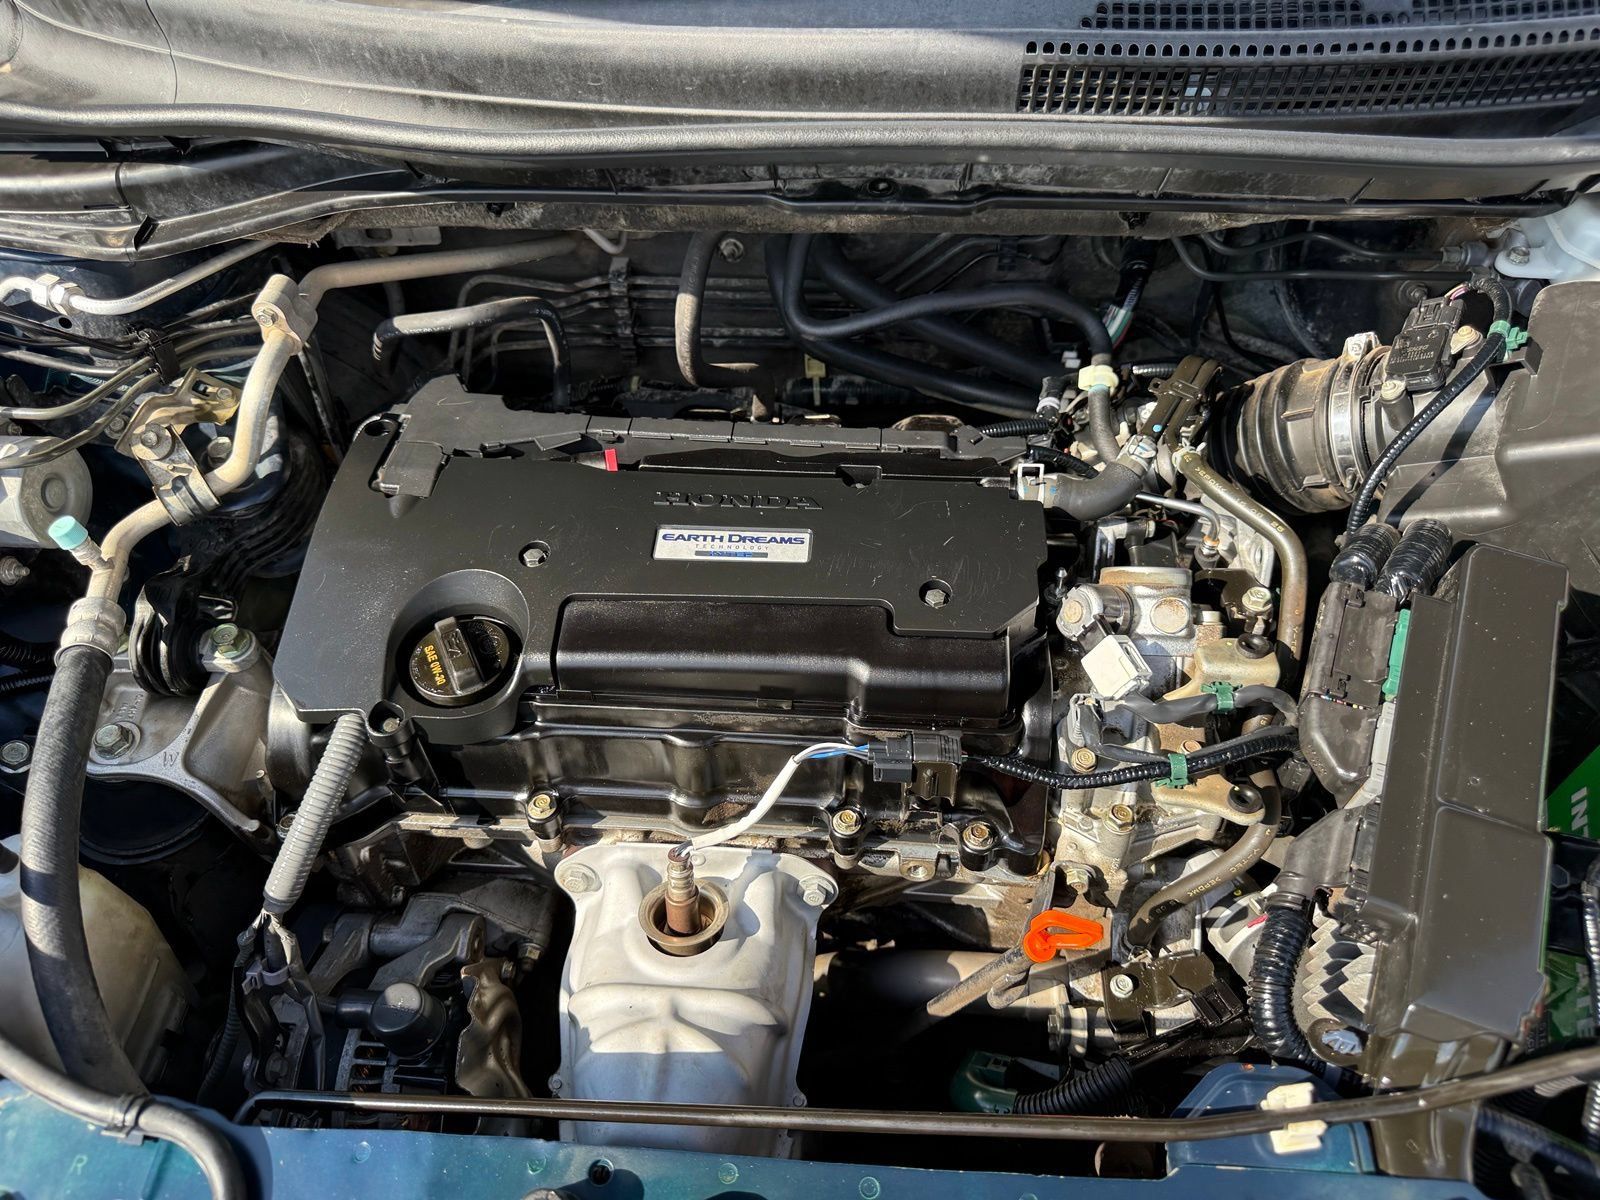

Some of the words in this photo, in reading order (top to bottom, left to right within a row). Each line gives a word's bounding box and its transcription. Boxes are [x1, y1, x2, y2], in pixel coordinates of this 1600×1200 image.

[653, 491, 823, 510] HONDA
[662, 533, 724, 543] EARTH
[728, 534, 805, 545] DREAMS
[695, 543, 769, 551] TECHNOLOGY
[424, 645, 438, 662] SAE
[430, 661, 446, 686] 0W-20
[1229, 848, 1261, 873] Y-TEC
